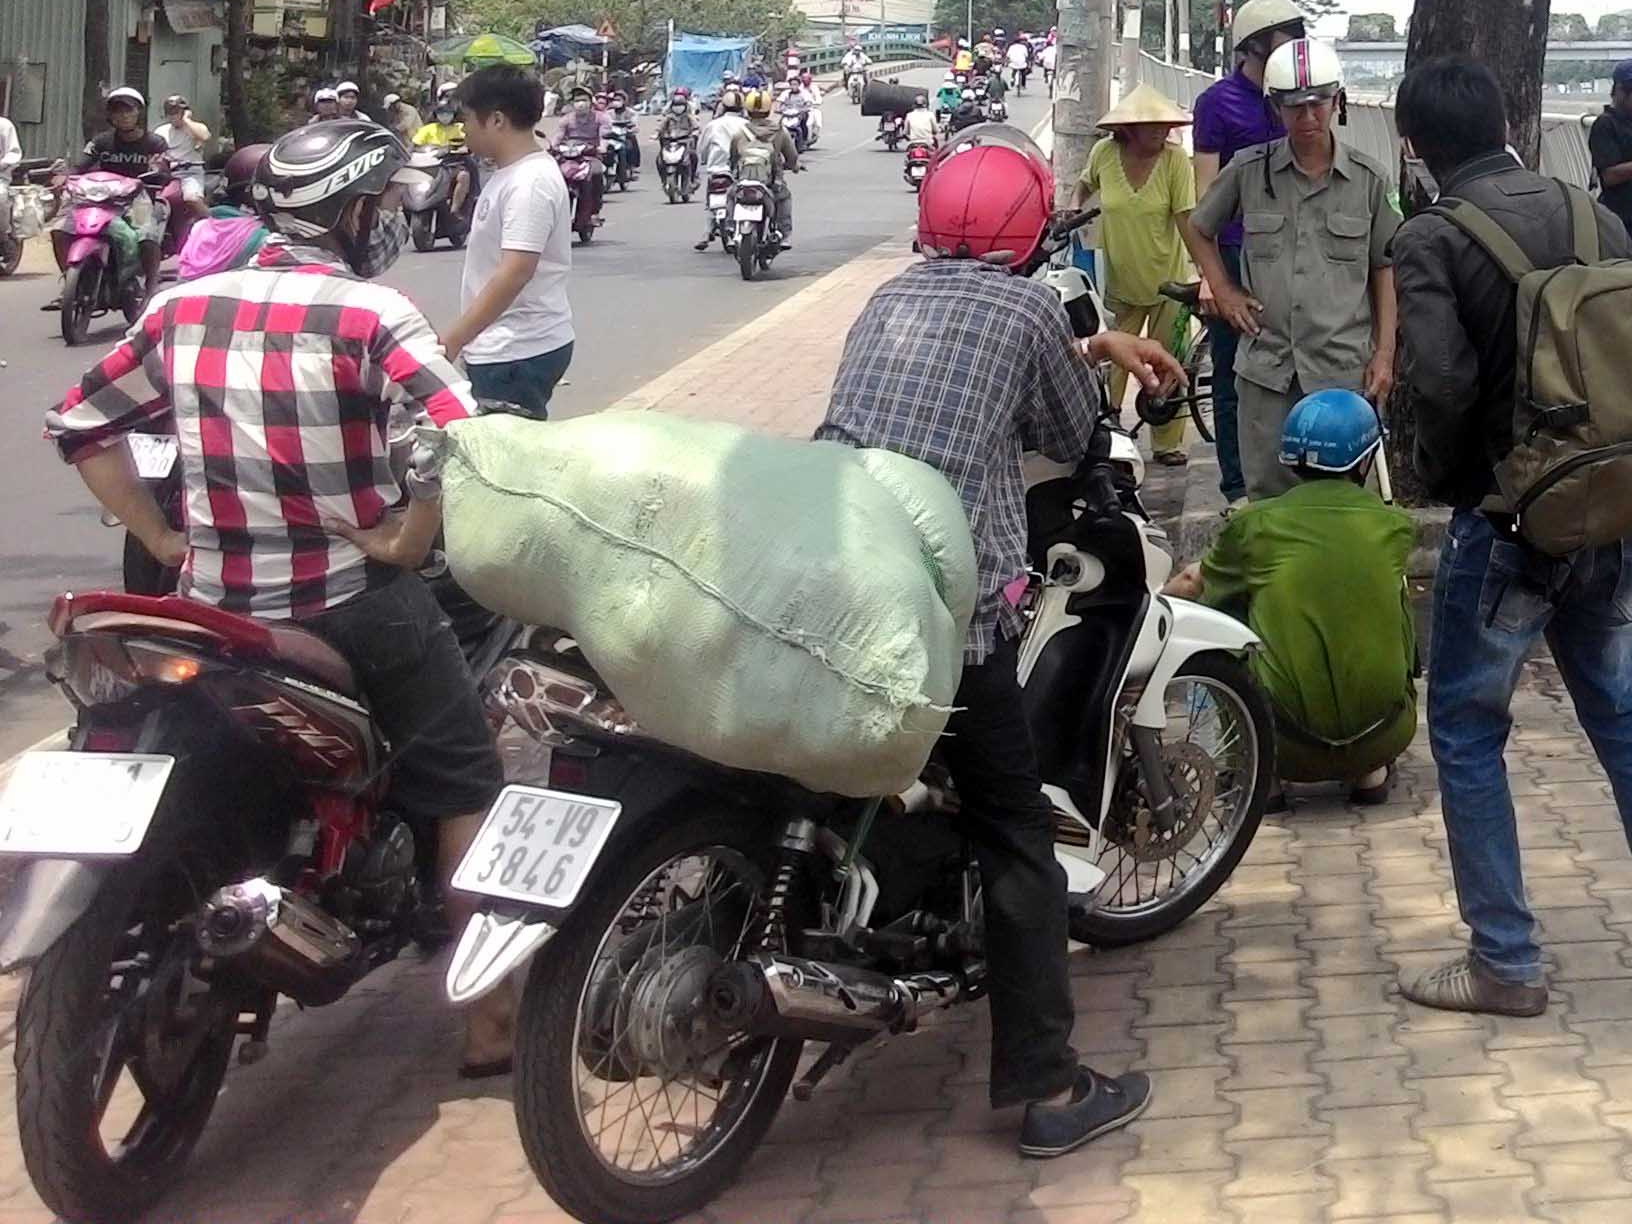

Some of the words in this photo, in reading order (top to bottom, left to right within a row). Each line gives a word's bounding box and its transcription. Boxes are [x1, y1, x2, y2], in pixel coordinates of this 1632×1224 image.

[100, 151, 147, 164] Calvin
[502, 796, 599, 849] 54-V9
[477, 842, 575, 895] 3846
